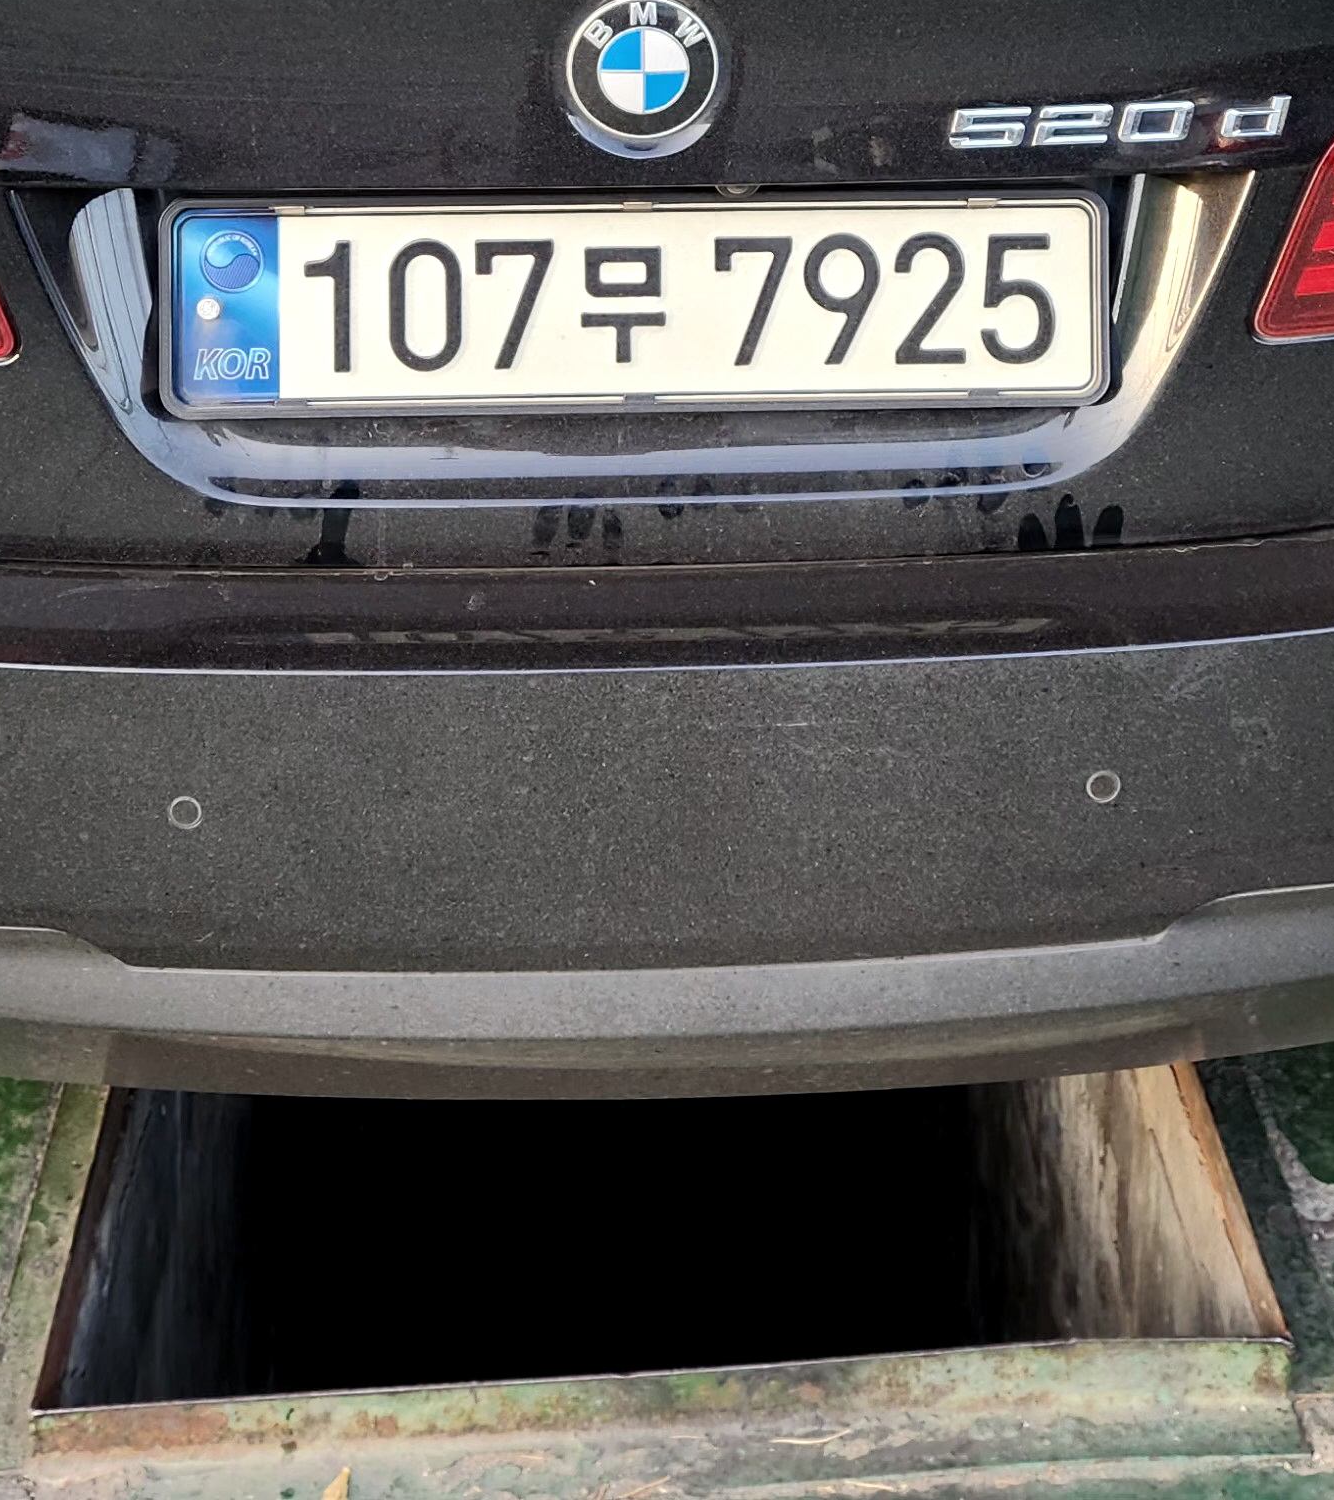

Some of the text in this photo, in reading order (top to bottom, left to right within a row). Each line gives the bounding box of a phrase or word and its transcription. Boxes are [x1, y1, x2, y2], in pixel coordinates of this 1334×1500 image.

[583, 1, 705, 50] BMW
[303, 232, 1055, 375] 107무 7925
[193, 347, 271, 380] KOR
